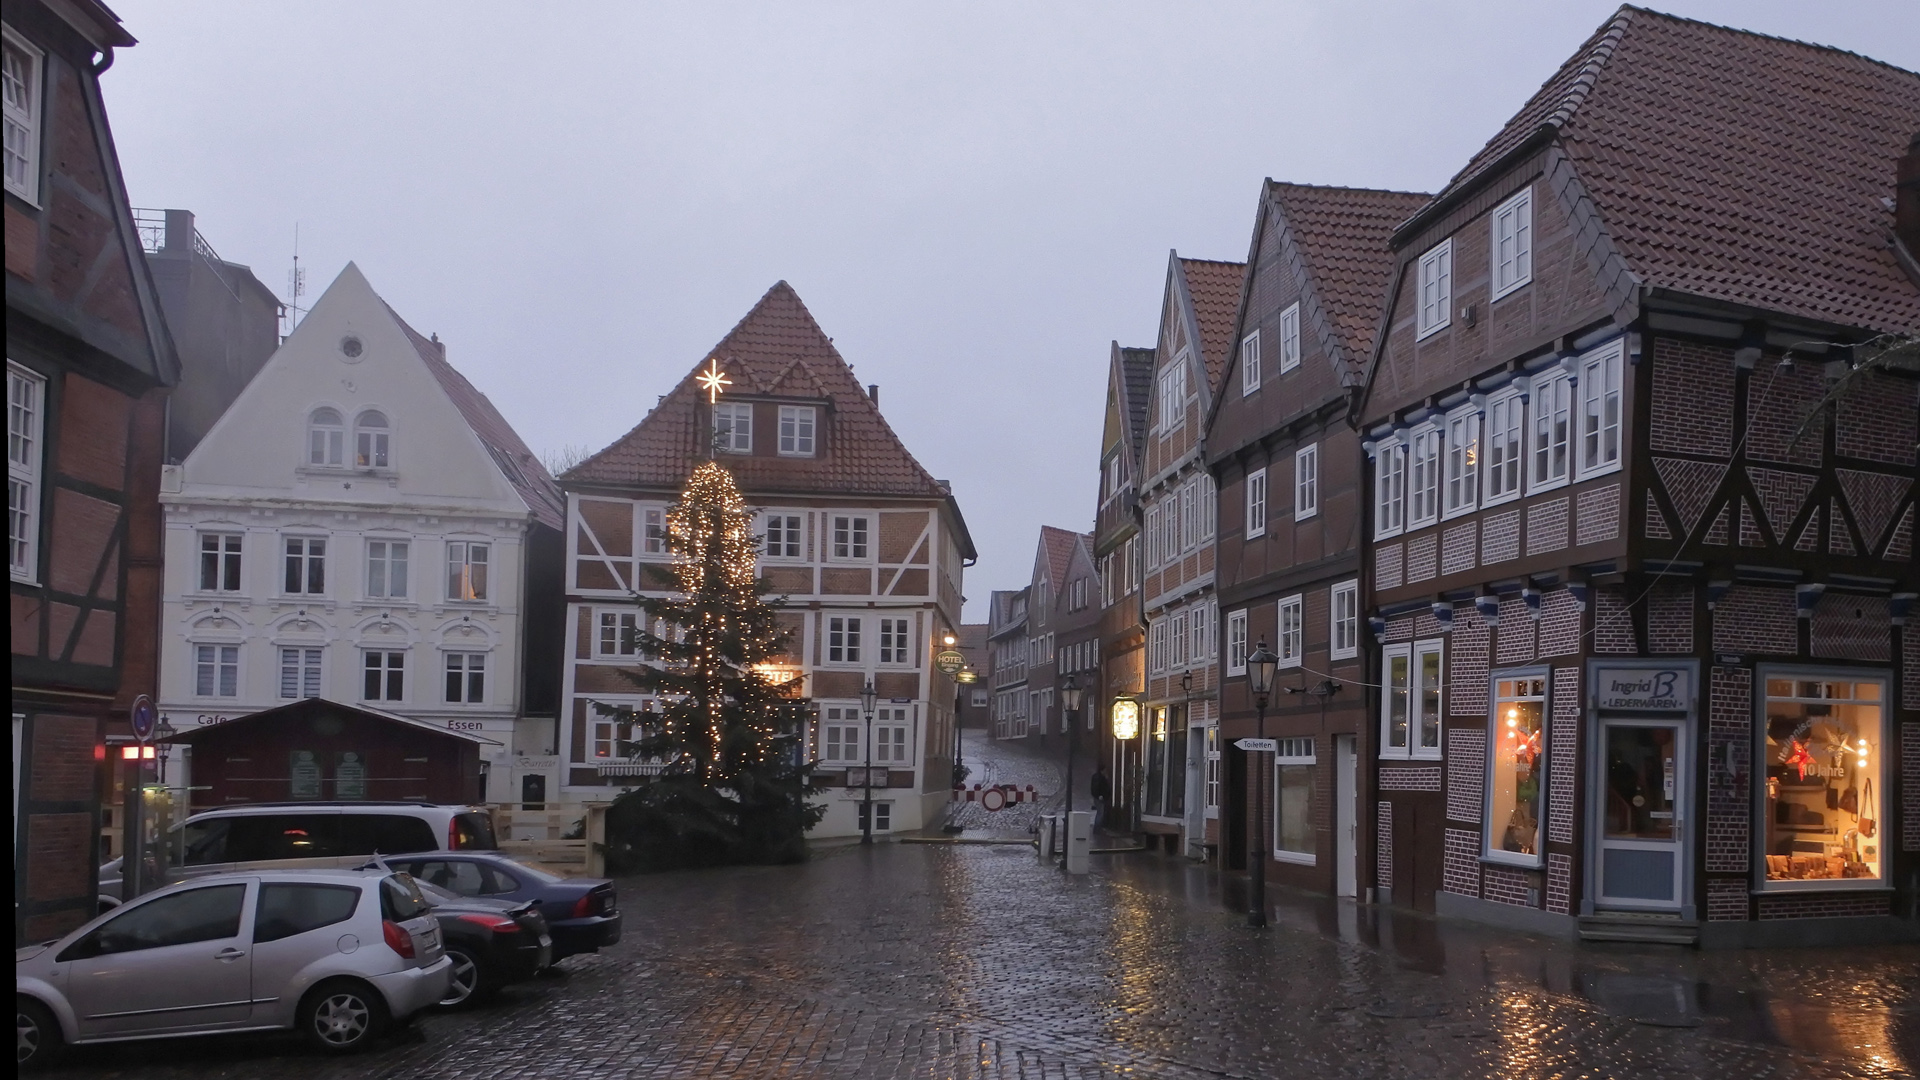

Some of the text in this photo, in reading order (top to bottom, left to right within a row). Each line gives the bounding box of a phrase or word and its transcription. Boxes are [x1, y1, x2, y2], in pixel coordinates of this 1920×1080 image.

[938, 655, 964, 664] HOTEL
[1611, 679, 1652, 695] Ingrid
[1608, 698, 1677, 708] LEDERWAREN
[448, 719, 482, 730] Essen
[1243, 740, 1272, 749] Toiletten
[1803, 764, 1845, 777] 10 Jahre
